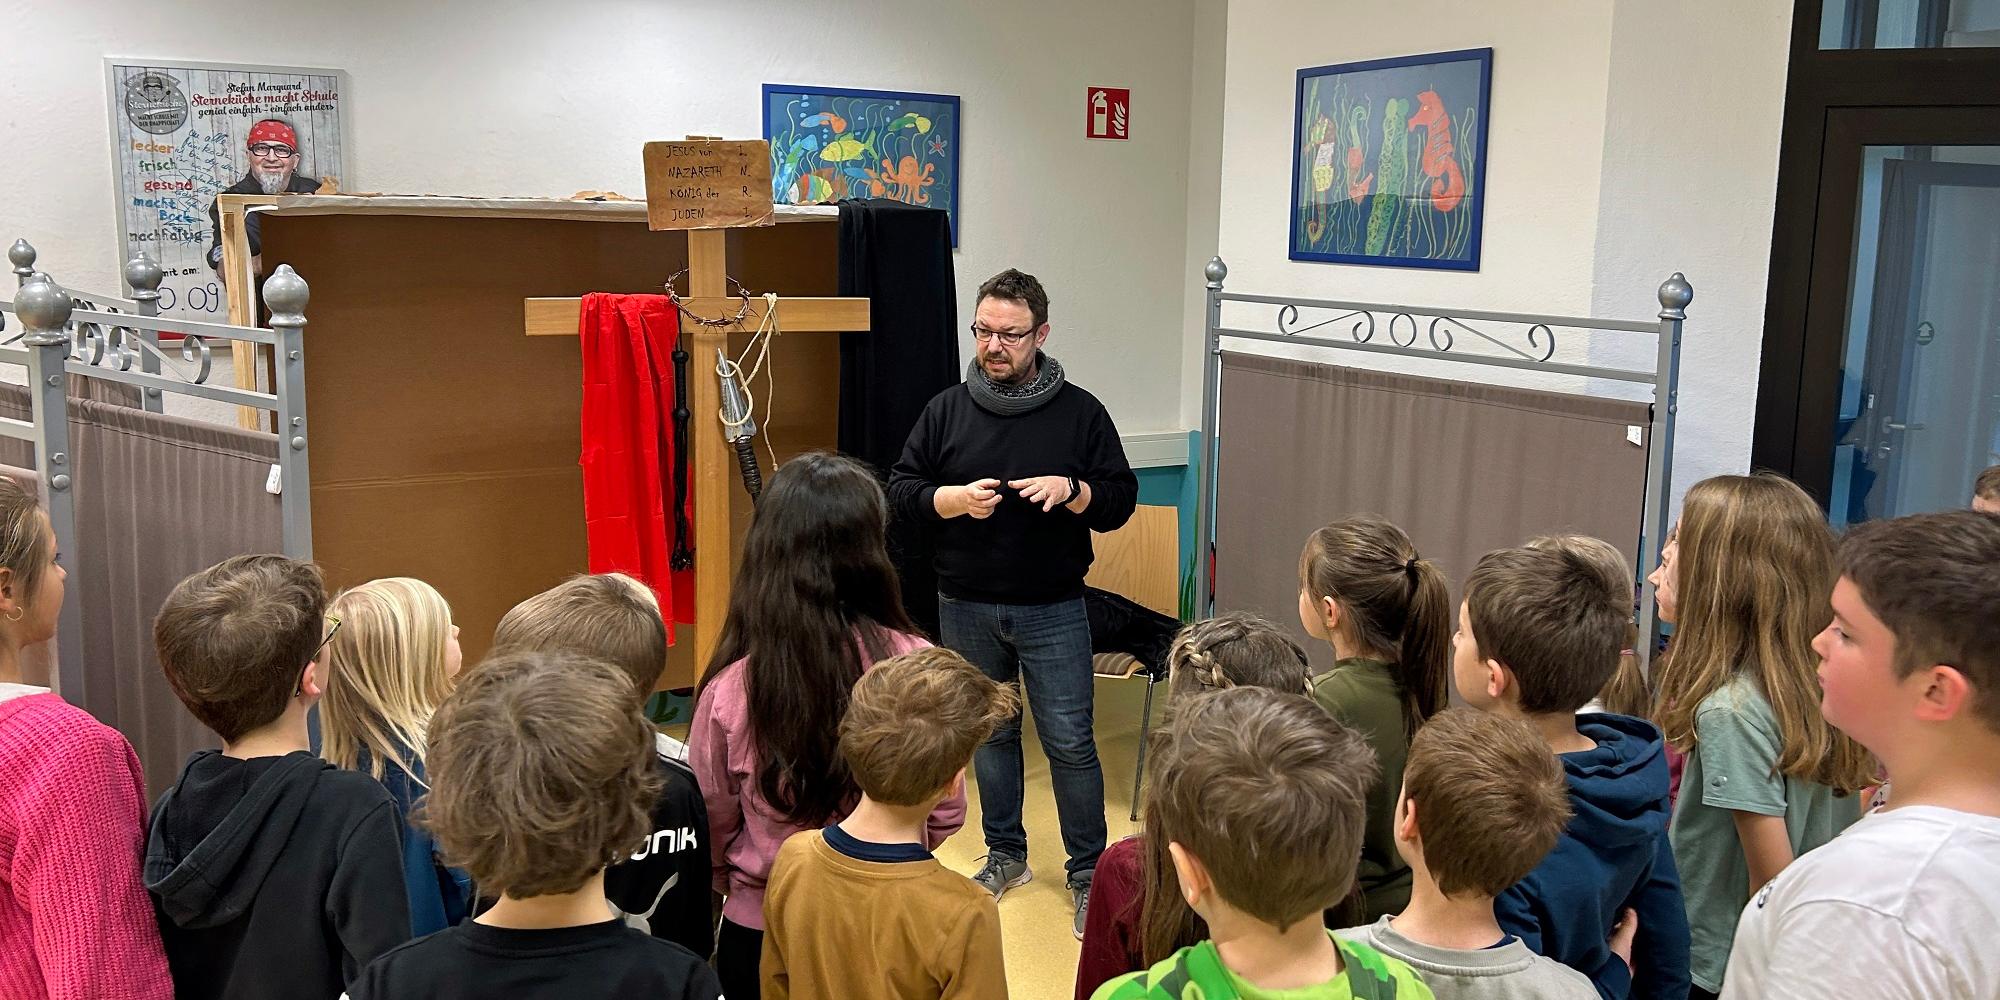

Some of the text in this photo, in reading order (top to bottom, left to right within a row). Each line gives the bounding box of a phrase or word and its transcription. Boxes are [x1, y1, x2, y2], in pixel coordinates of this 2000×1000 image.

[226, 81, 302, 95] Stefan Marquard
[191, 89, 338, 107] Sterneküche macht Schule
[198, 106, 227, 119] genial
[228, 104, 262, 117] einfach
[270, 102, 303, 115] einfach
[304, 100, 334, 112] anders
[131, 138, 175, 154] lecker
[665, 144, 712, 158] JESUS von
[138, 157, 178, 172] frisch
[740, 165, 751, 177] N.
[667, 165, 722, 179] NAZARETH
[144, 179, 193, 193] gesund
[669, 185, 720, 199] KÖNIG der
[742, 185, 752, 198] R.
[133, 196, 177, 209] macht
[671, 207, 705, 222] JUDEN
[129, 228, 204, 243] nachhaltig
[182, 267, 200, 276] am:
